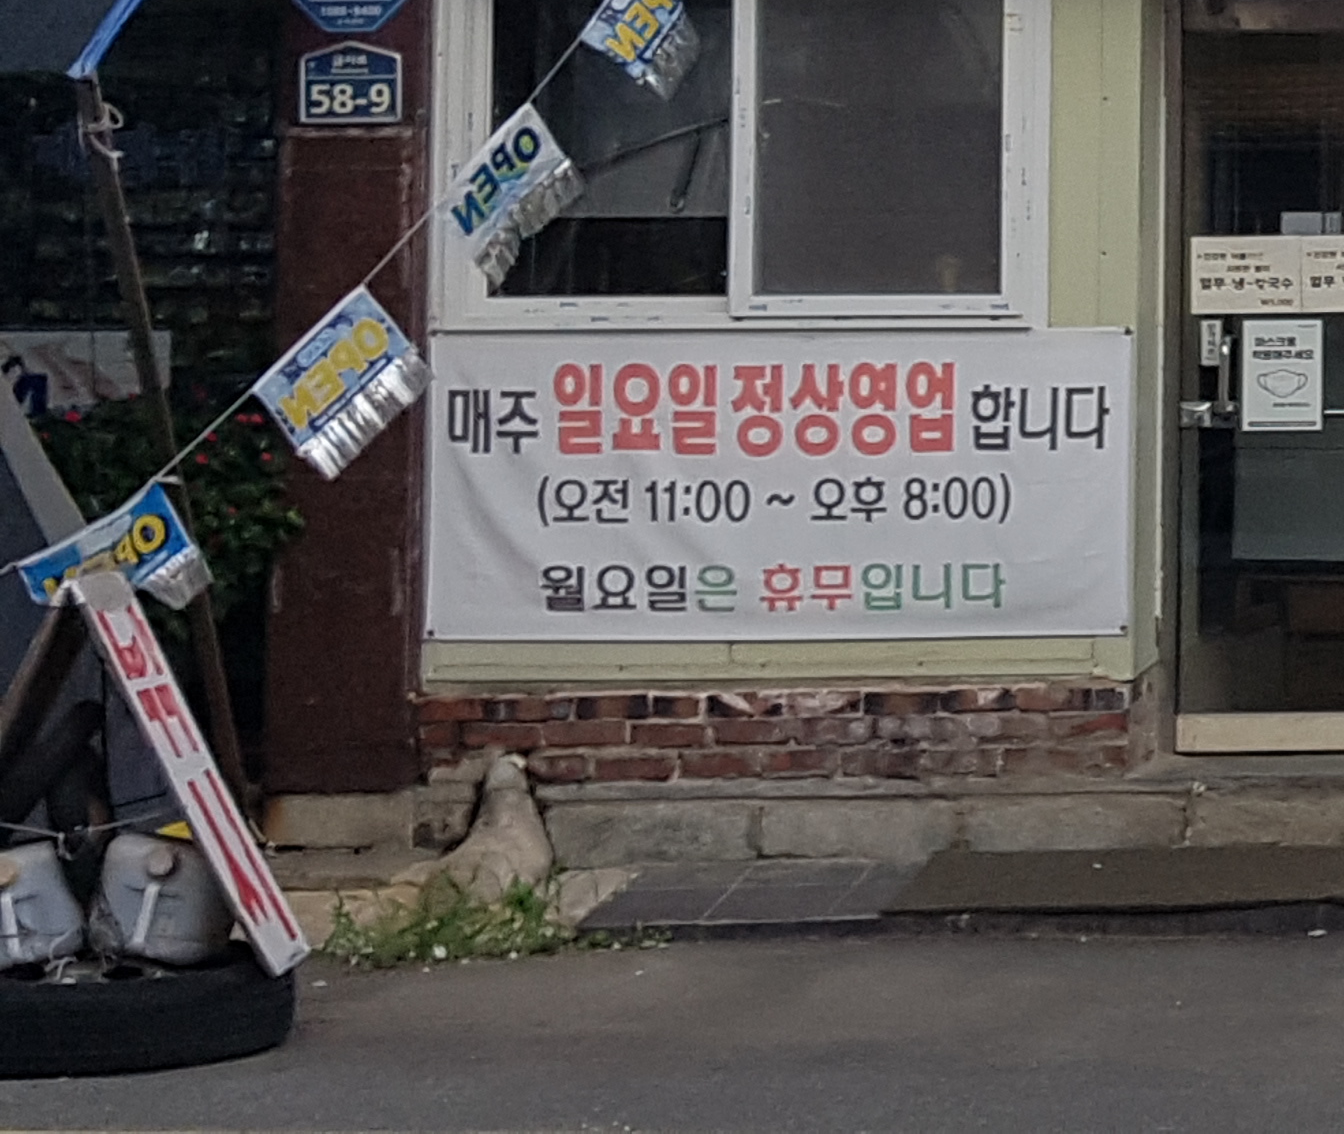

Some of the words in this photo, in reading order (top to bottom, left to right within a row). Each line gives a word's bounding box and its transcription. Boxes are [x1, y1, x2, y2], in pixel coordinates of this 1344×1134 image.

[310, 83, 391, 114] 58-9
[447, 389, 538, 455] 매주
[970, 383, 1110, 450] 합니다
[536, 475, 630, 526] (오전
[646, 479, 750, 522] 11:00
[811, 477, 889, 522] 오후
[903, 473, 1012, 524] 8:00)
[540, 564, 737, 612] 월요일은
[759, 563, 1006, 611] 휴무입니다
